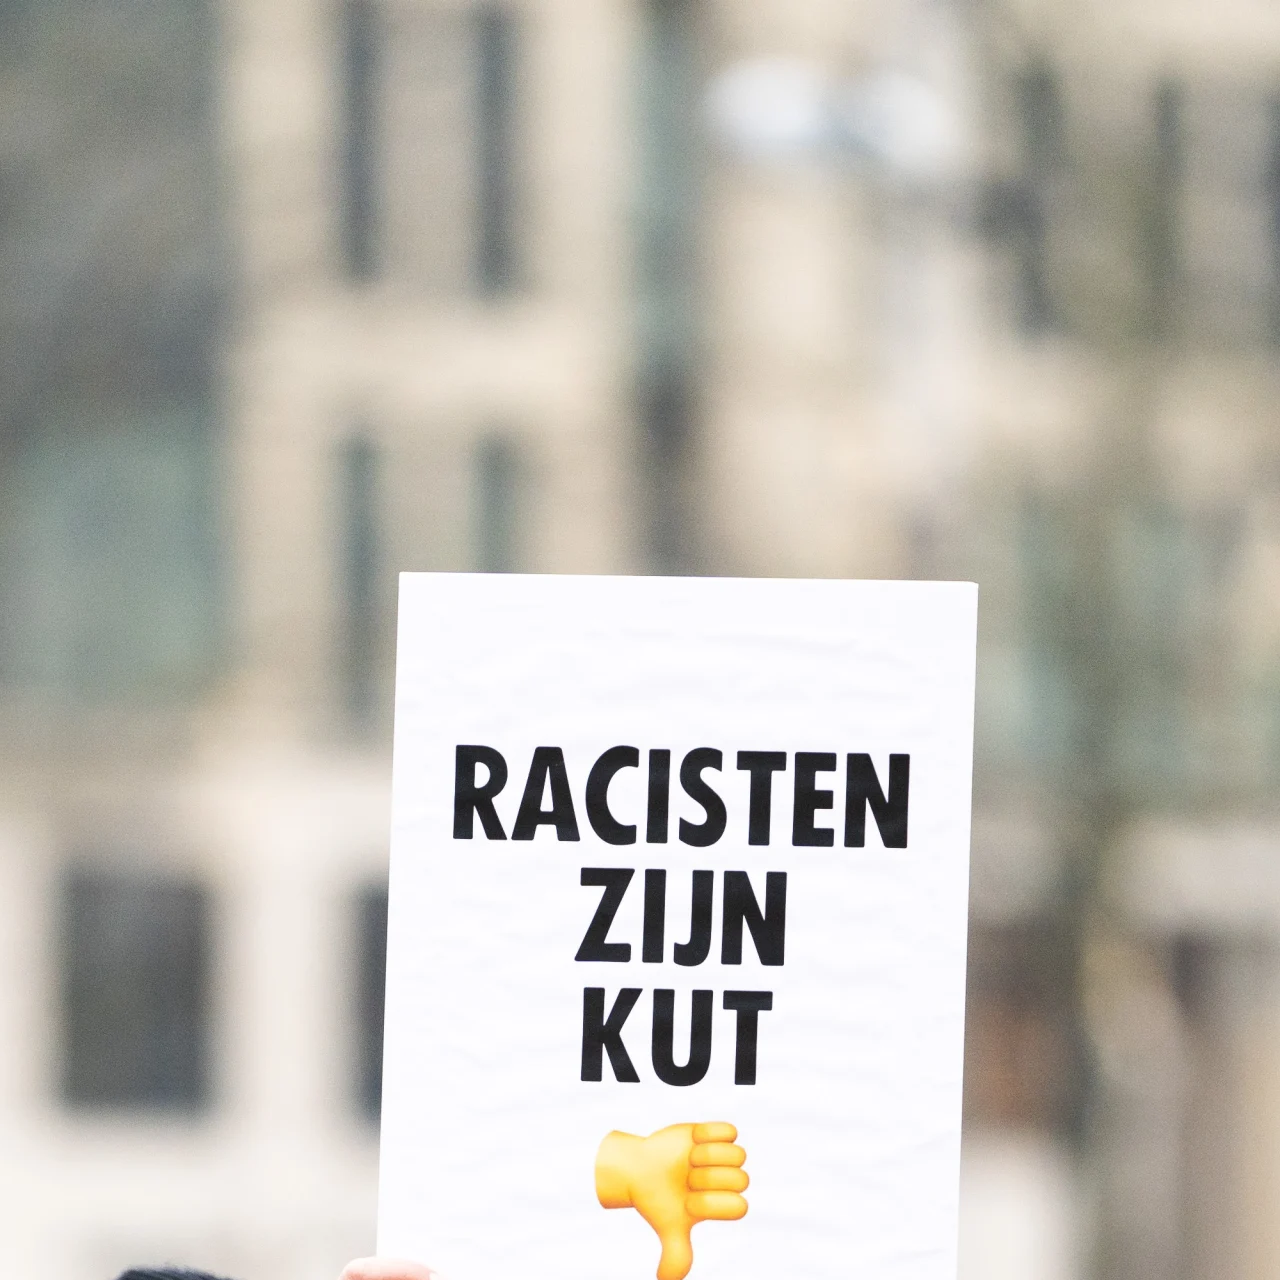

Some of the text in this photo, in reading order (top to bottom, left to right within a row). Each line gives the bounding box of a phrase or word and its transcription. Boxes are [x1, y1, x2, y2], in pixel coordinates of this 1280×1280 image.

[453, 745, 910, 848] RACISTEN
[575, 868, 787, 966] ZIJN
[581, 987, 773, 1086] KUT
